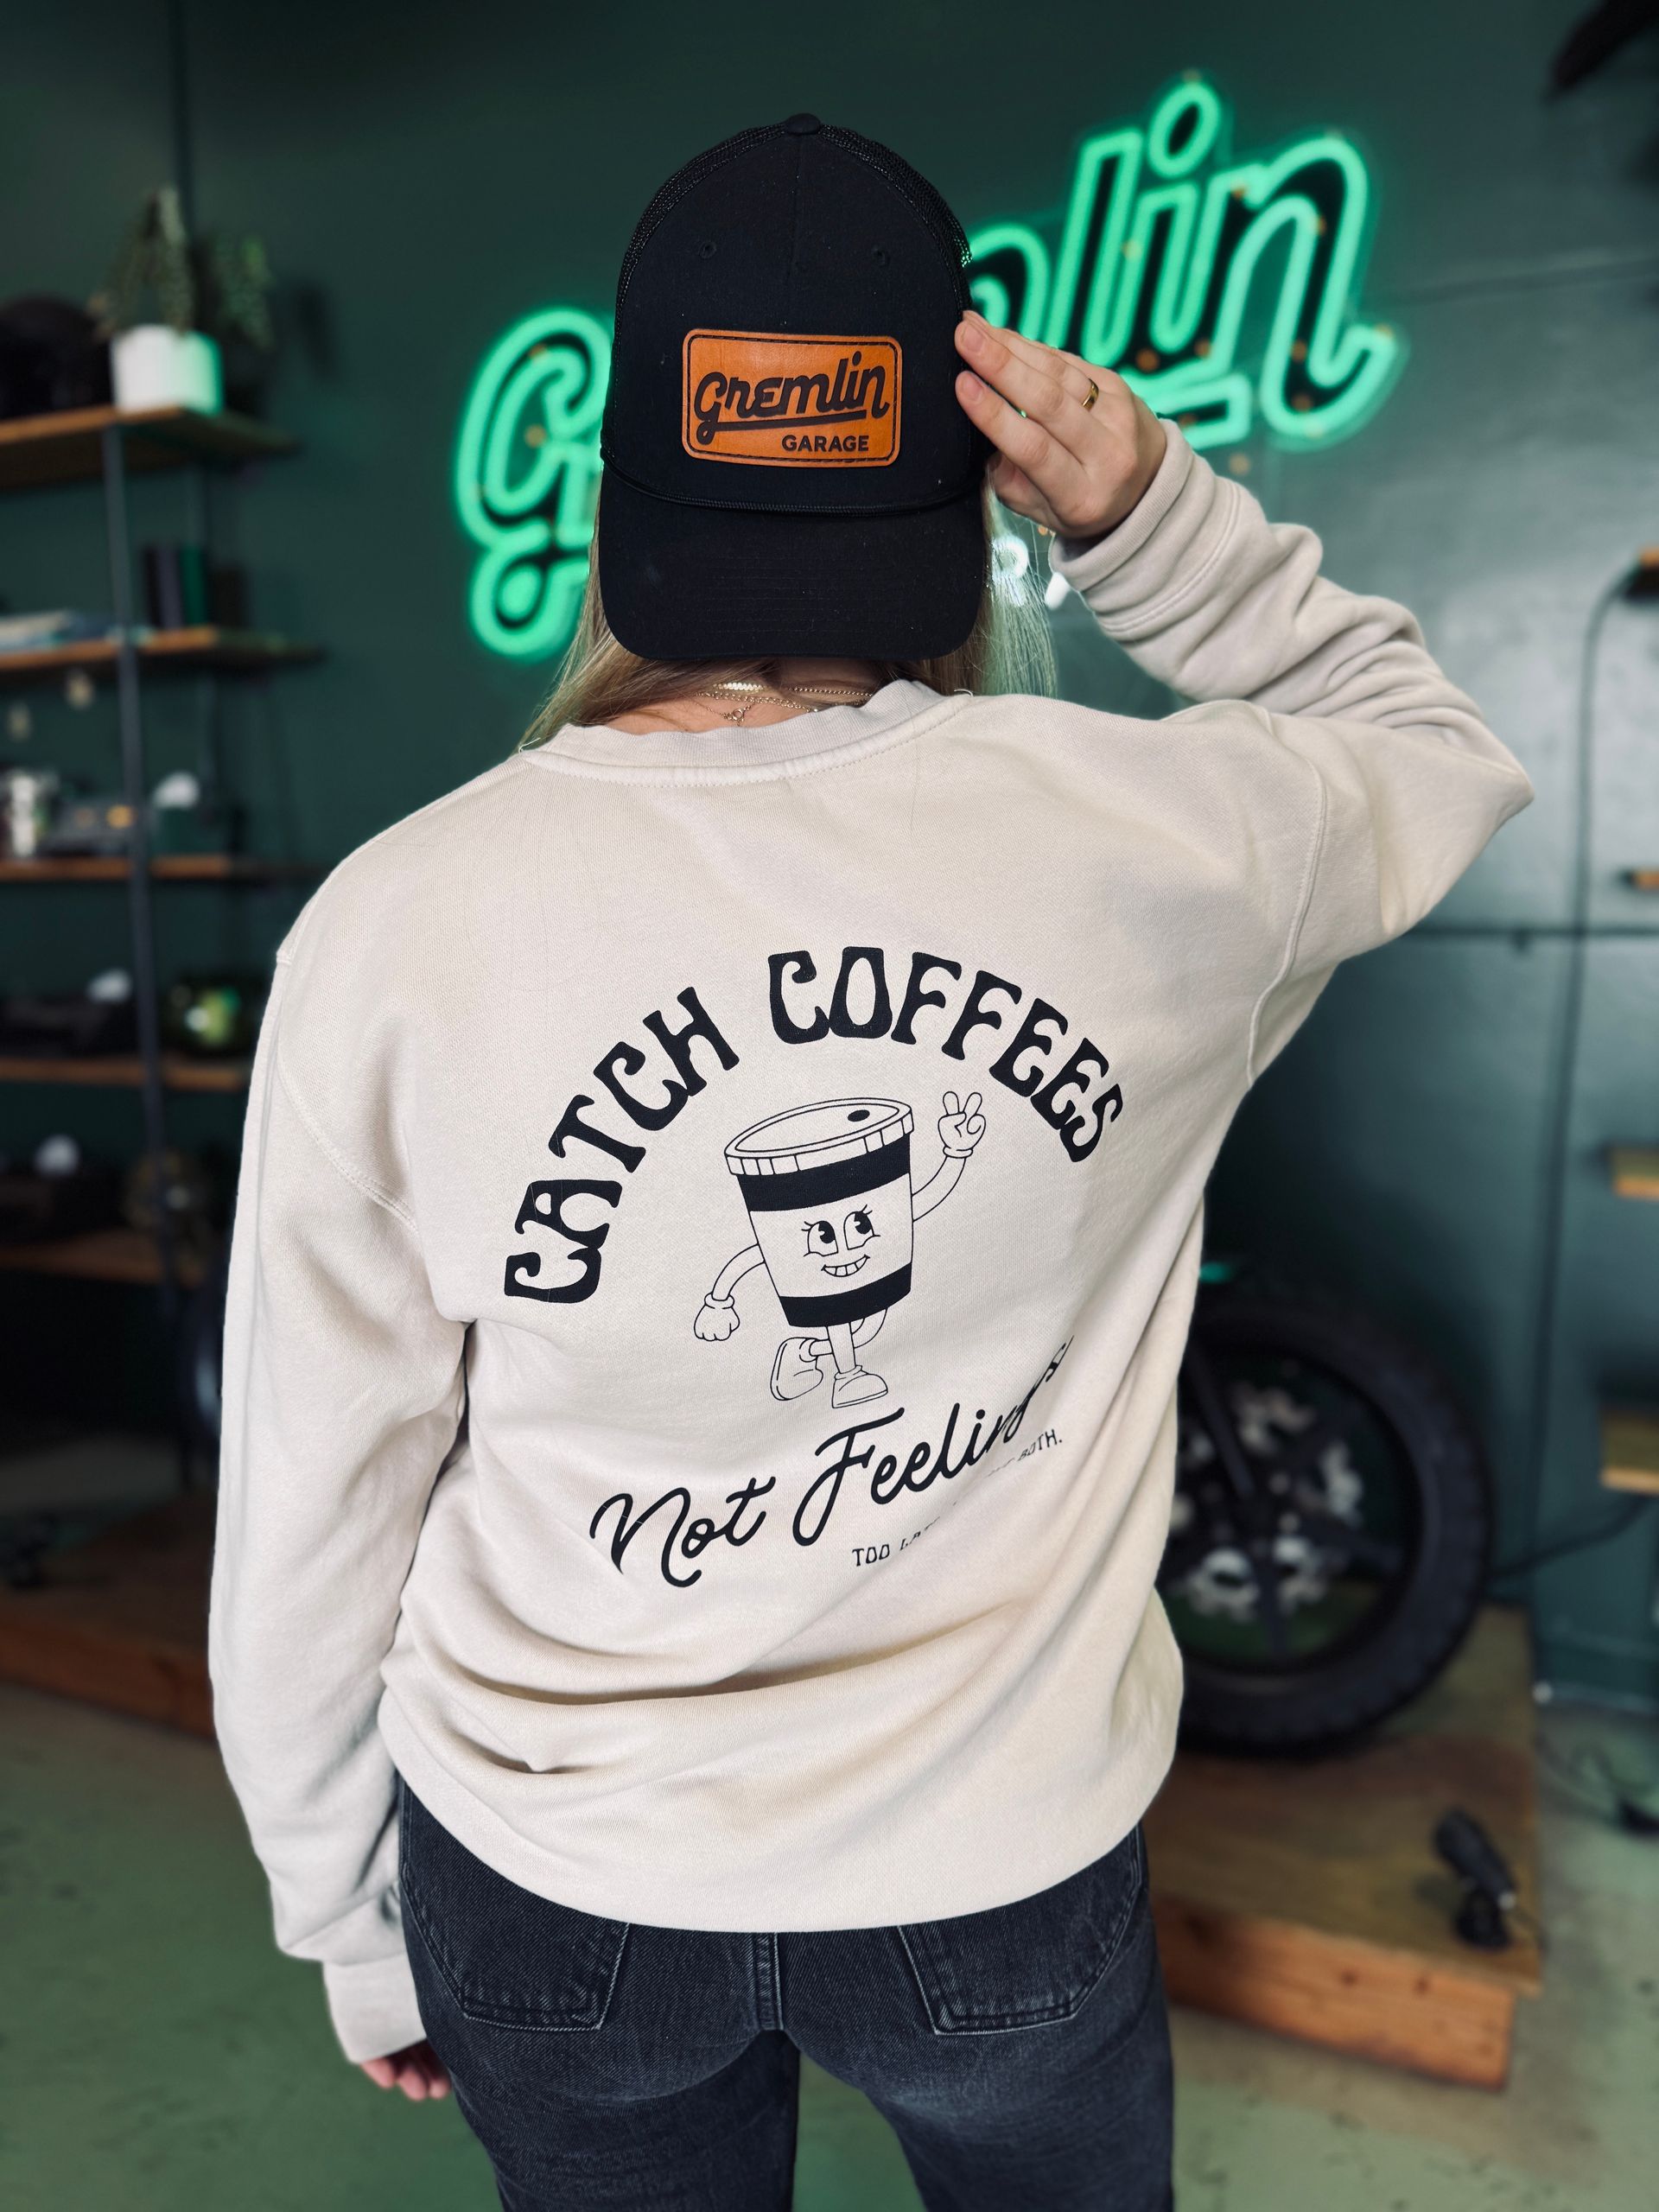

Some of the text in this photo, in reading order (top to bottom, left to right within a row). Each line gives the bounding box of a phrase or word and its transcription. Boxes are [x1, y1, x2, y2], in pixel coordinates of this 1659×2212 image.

[782, 435, 869, 453] GARAGE
[504, 945, 1123, 1304] CATCH COFFEES
[589, 1476, 777, 1588] Not
[851, 1543, 891, 1567] TOO
